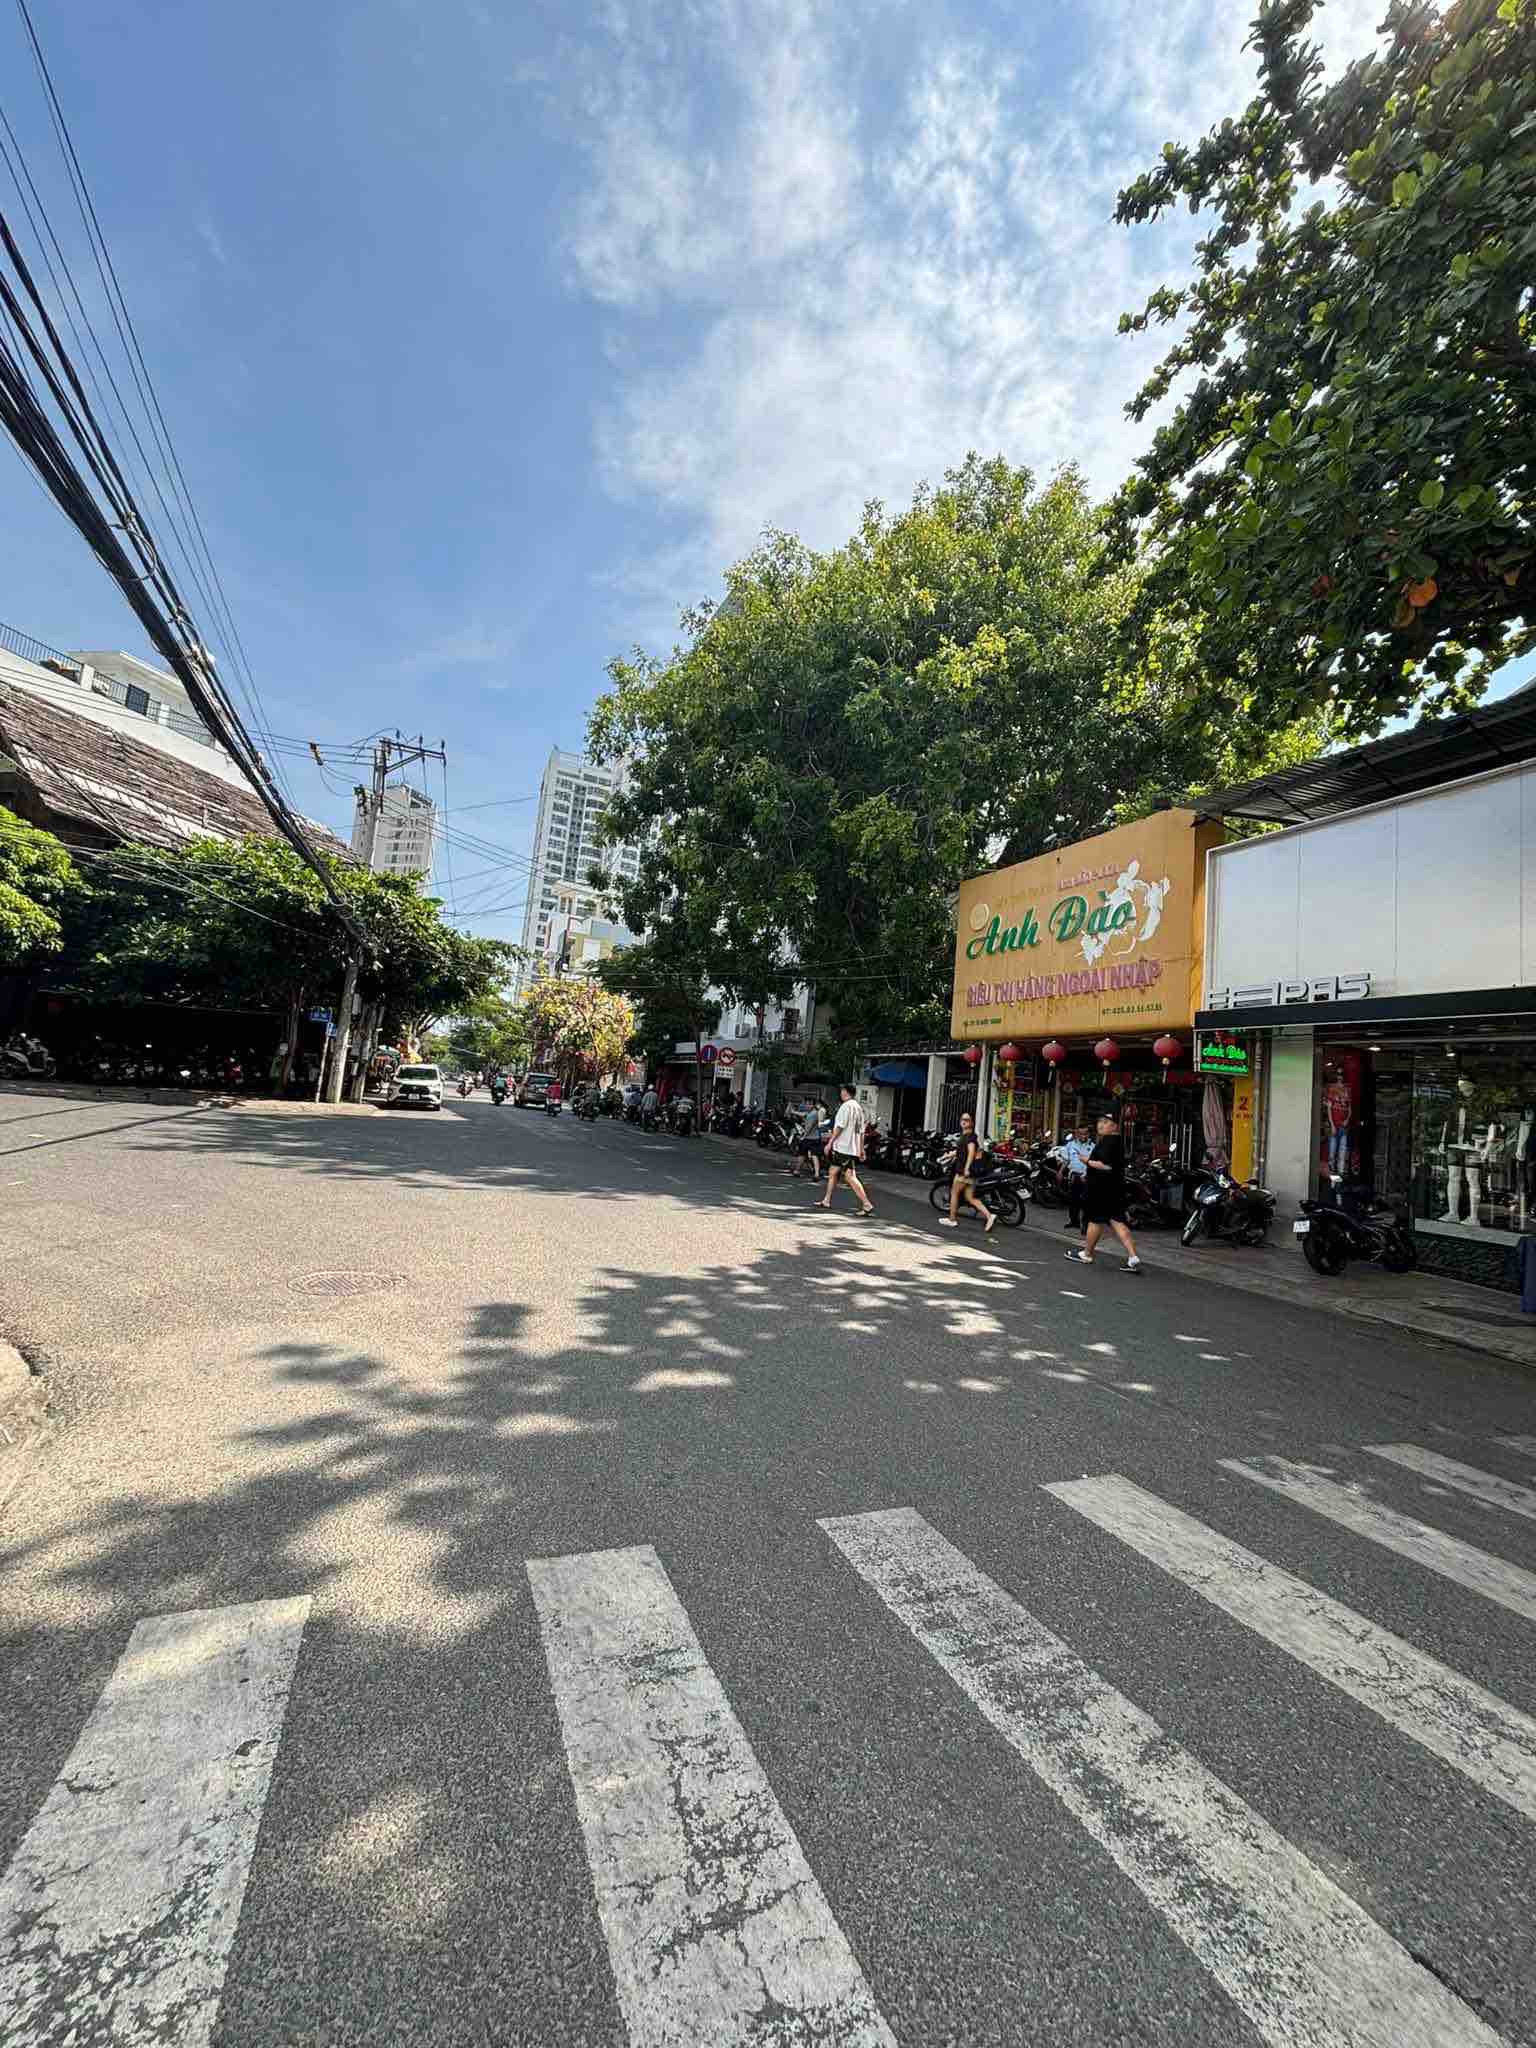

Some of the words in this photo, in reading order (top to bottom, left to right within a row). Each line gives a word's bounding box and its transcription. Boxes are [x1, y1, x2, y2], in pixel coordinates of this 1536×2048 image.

[967, 906, 1040, 960] Anh
[1056, 969, 1107, 998] NGOẠI
[1108, 957, 1163, 994] NHẬP
